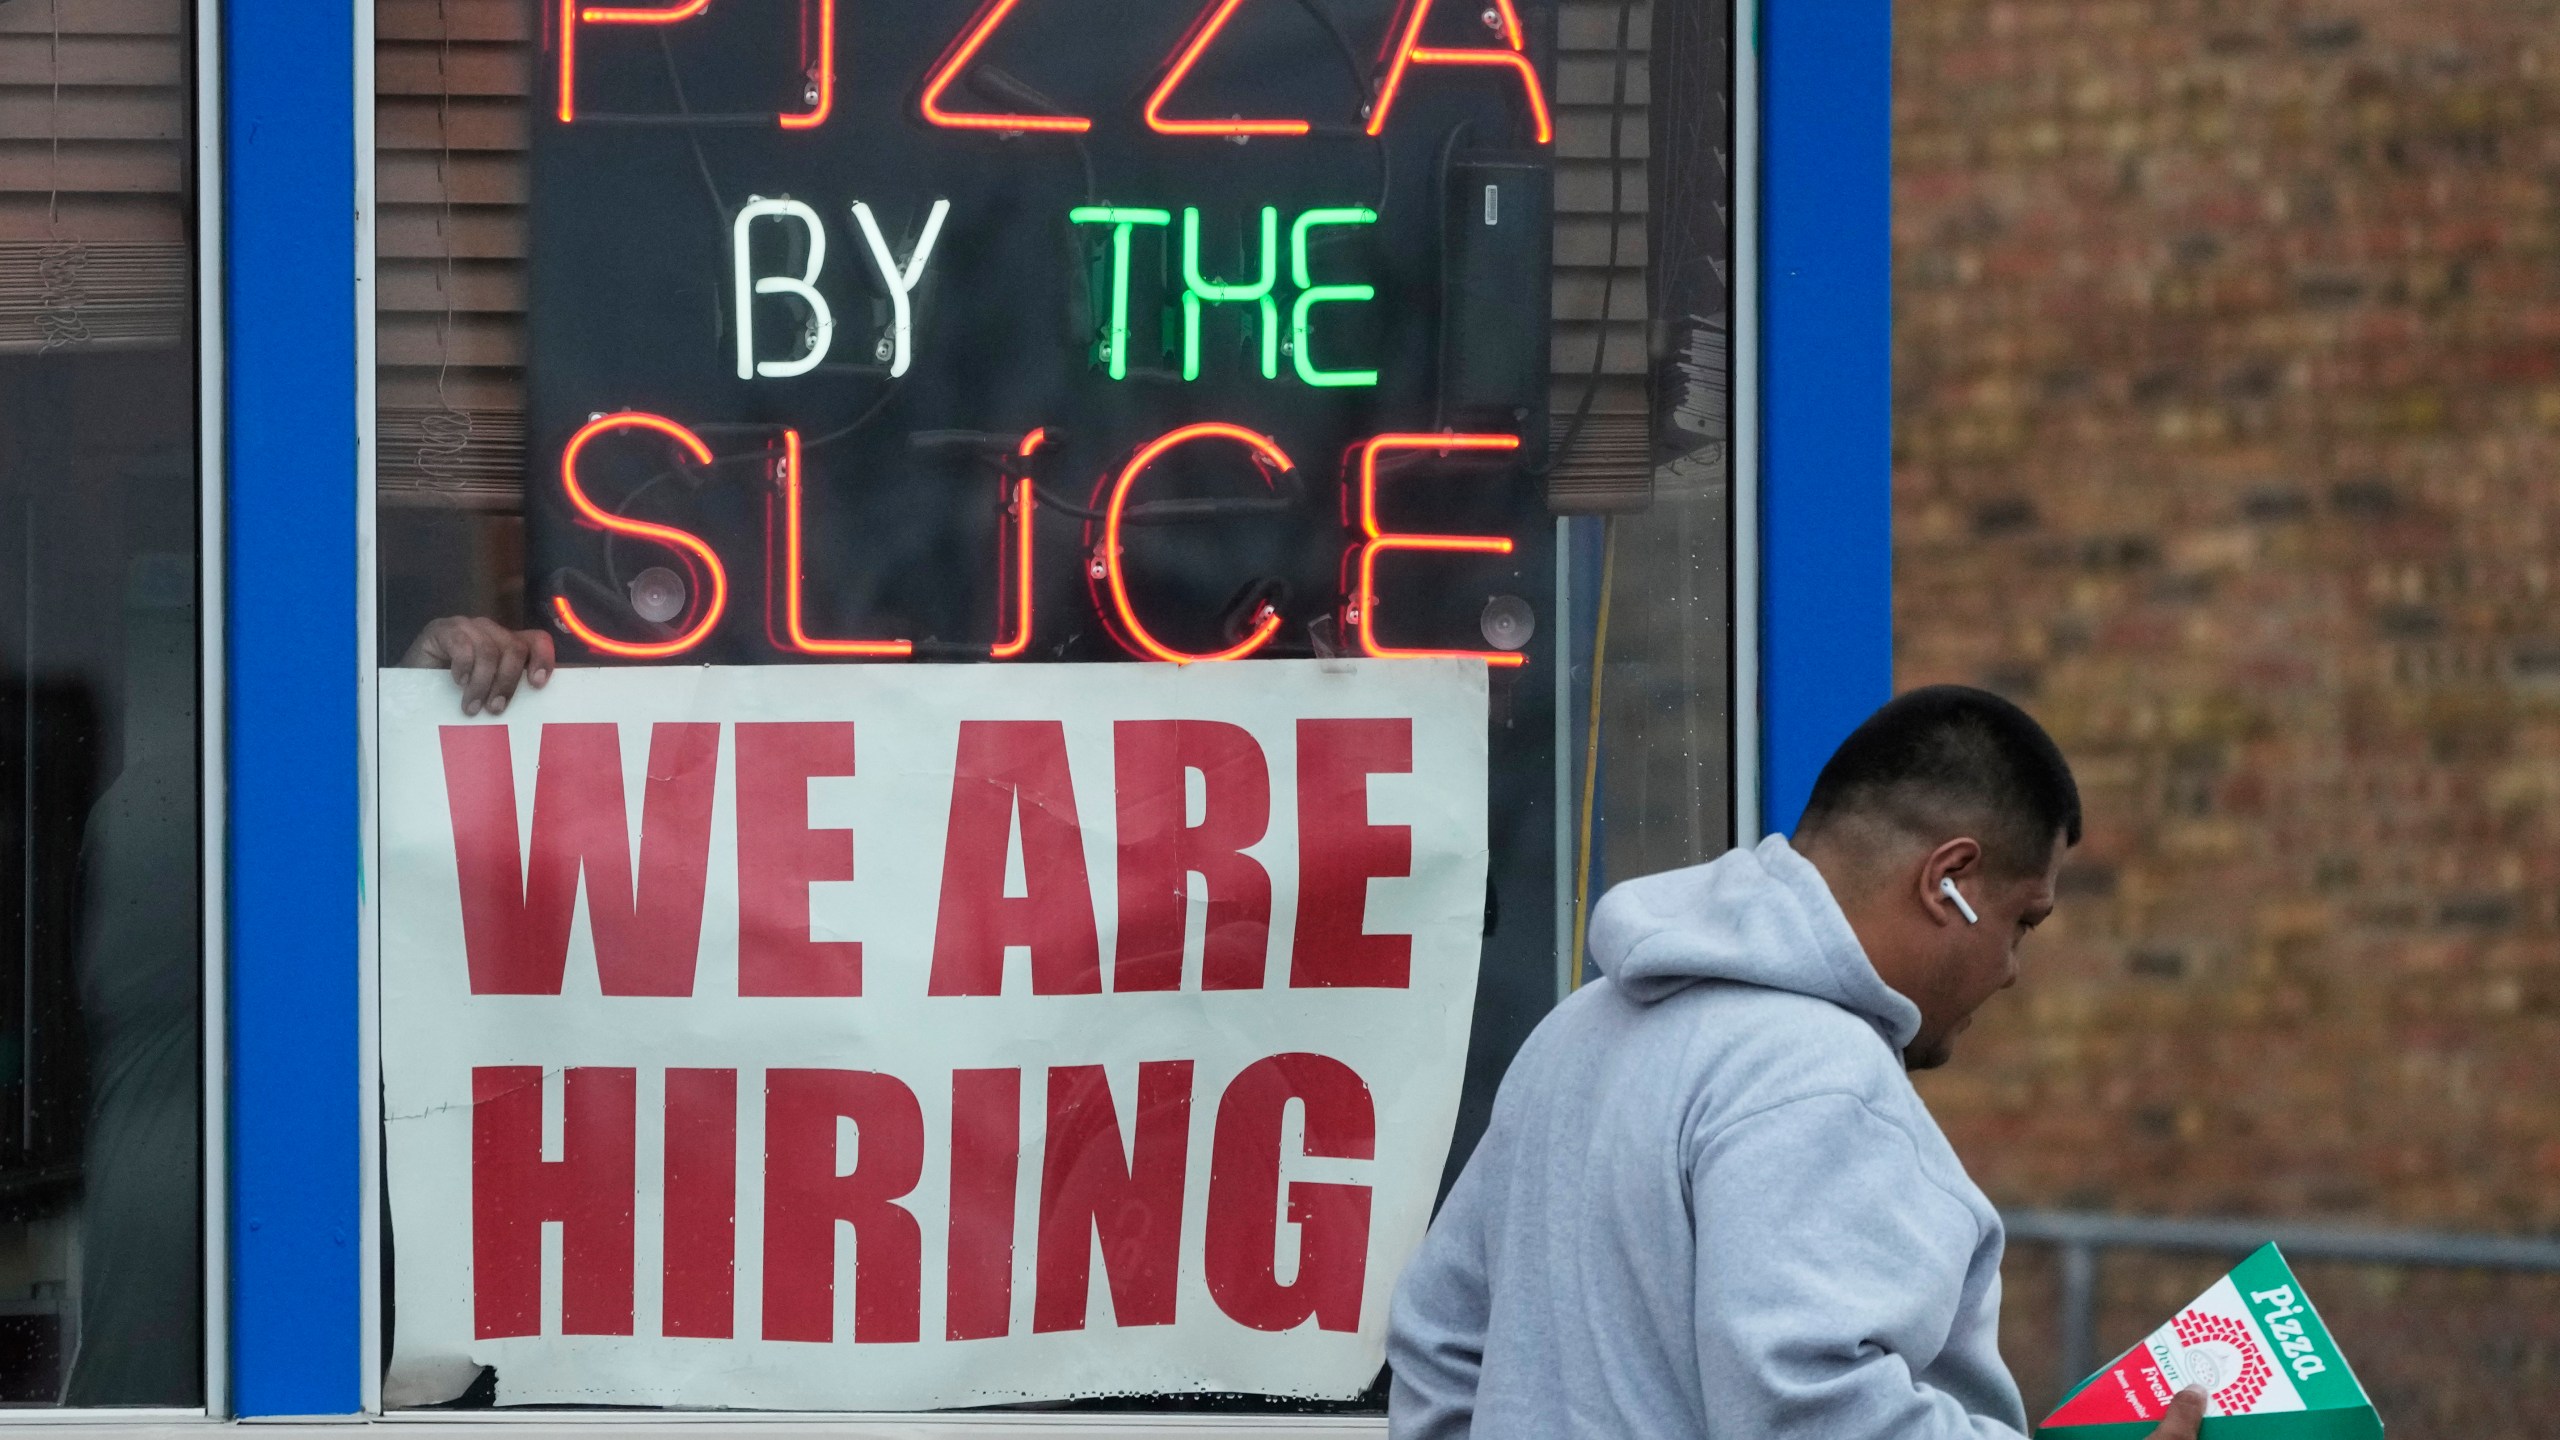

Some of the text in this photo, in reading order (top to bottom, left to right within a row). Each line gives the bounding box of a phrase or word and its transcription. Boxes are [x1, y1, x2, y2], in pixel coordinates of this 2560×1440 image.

[557, 0, 1552, 144] PIZZA
[733, 197, 1378, 387] BY THE
[551, 411, 1526, 666] SLICE
[438, 717, 1413, 998] WE ARE
[471, 1051, 1377, 1344] HIRING
[2140, 1366, 2174, 1406] Fresh
[2153, 1345, 2179, 1380] Oven
[2250, 1284, 2326, 1381] Pizza
